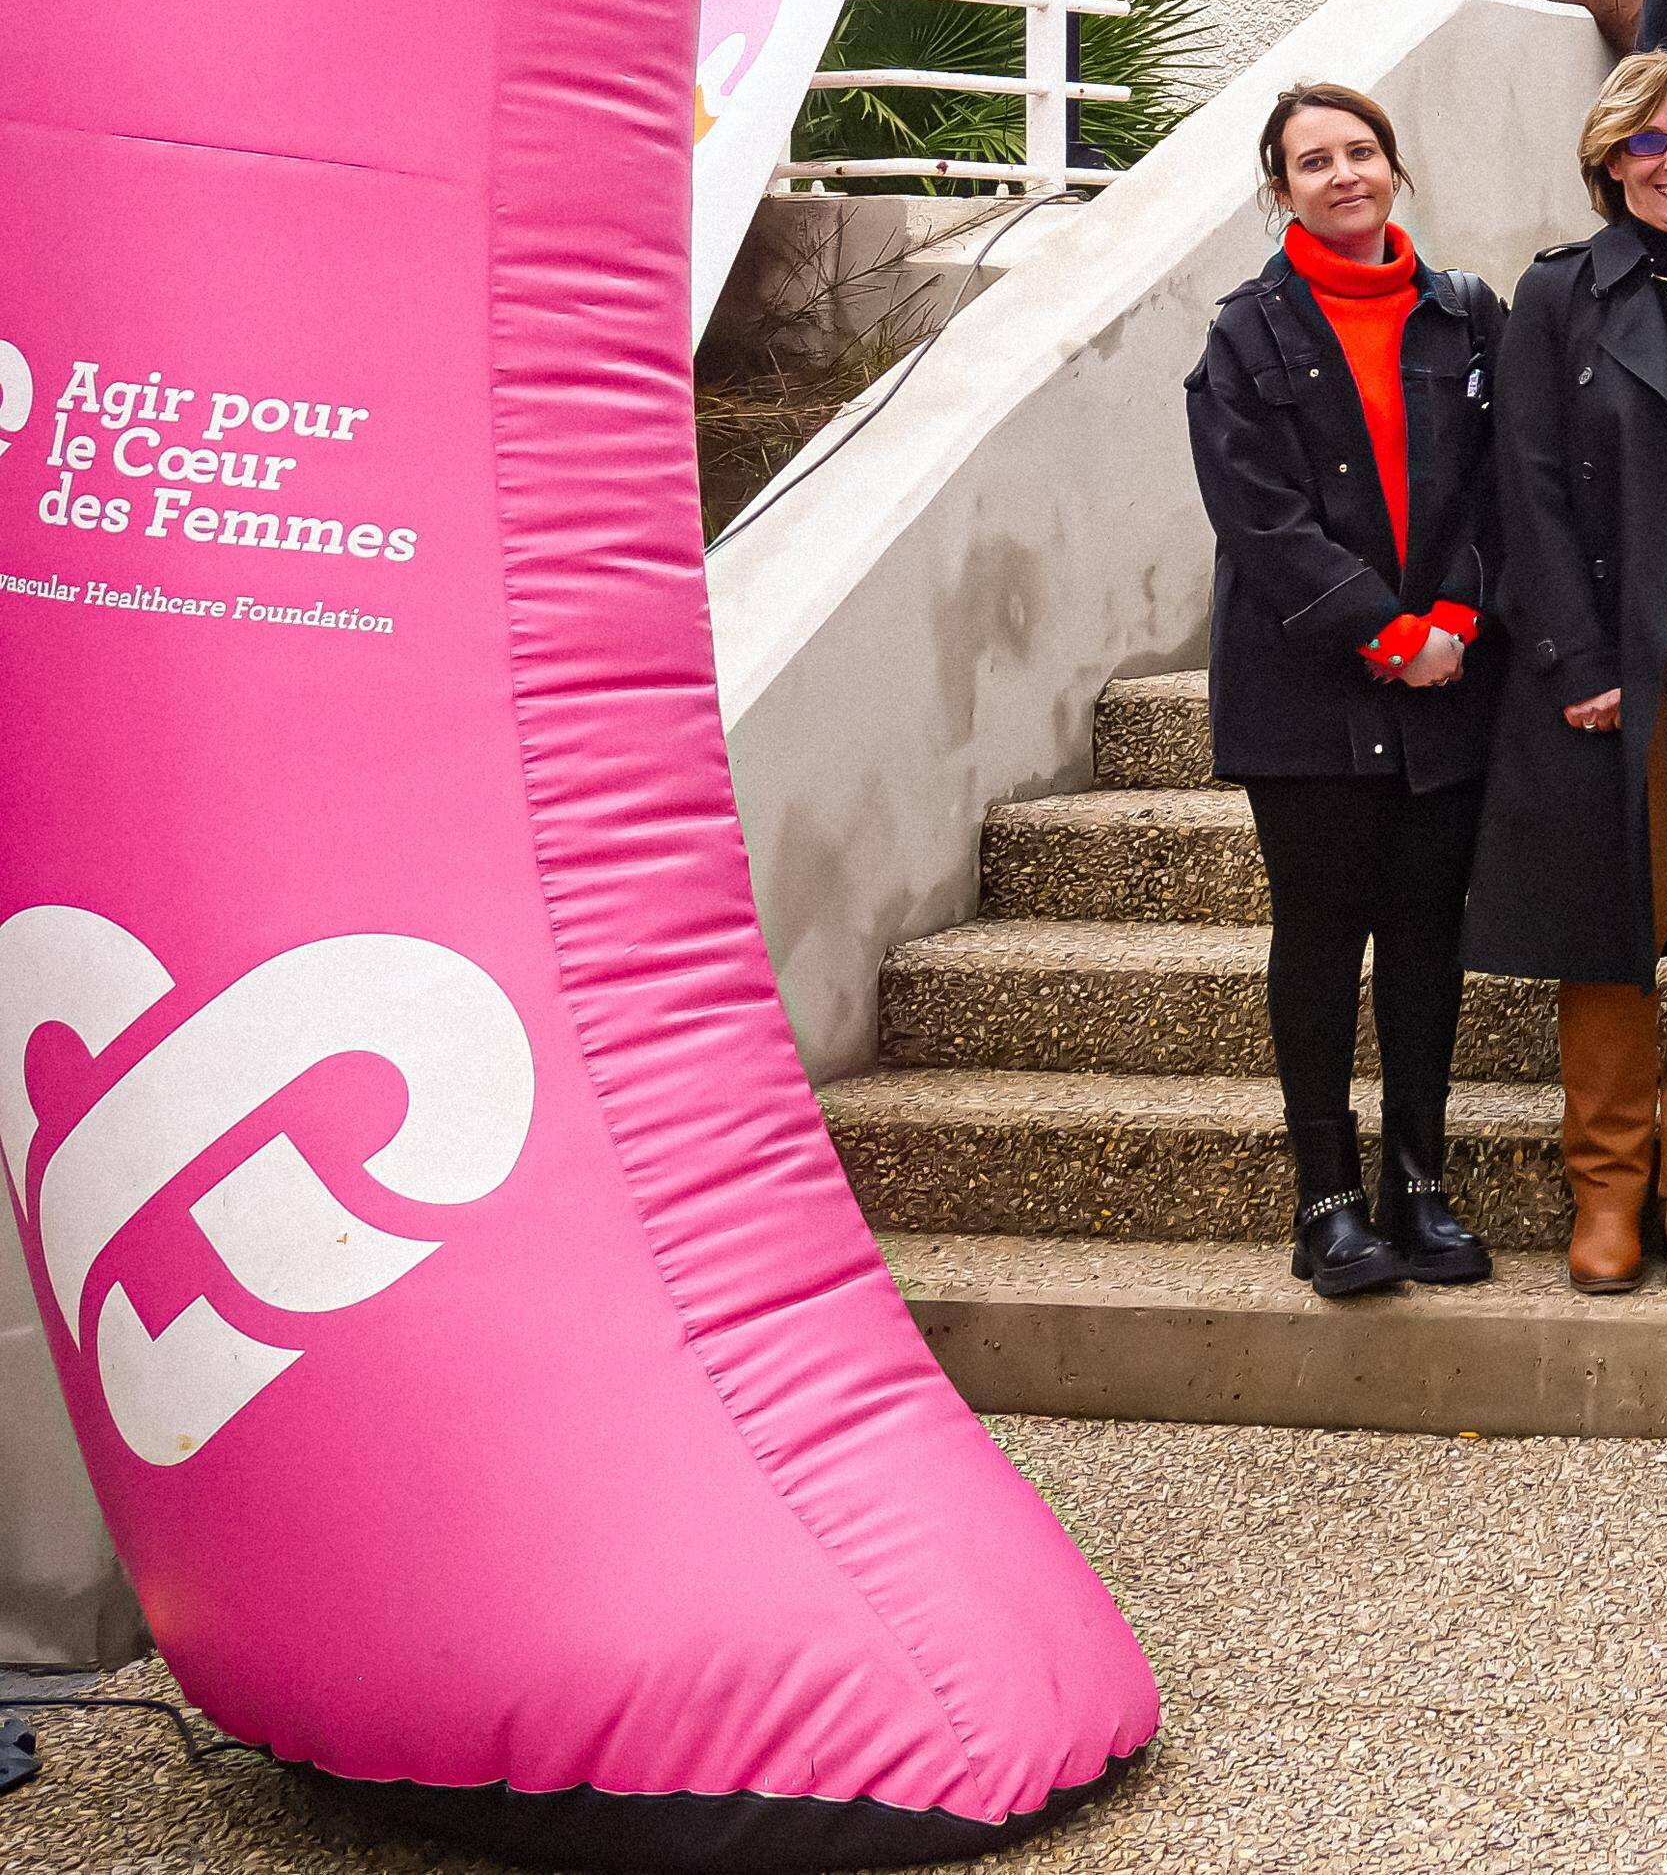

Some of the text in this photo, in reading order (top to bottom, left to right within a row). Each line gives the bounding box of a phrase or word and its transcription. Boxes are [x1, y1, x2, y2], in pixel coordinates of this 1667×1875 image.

[56, 361, 370, 441] Agir pour
[46, 412, 297, 491] le Cœur
[38, 471, 419, 562] des Femmes
[84, 581, 227, 619] Healthcare
[232, 597, 394, 634] Foundation
